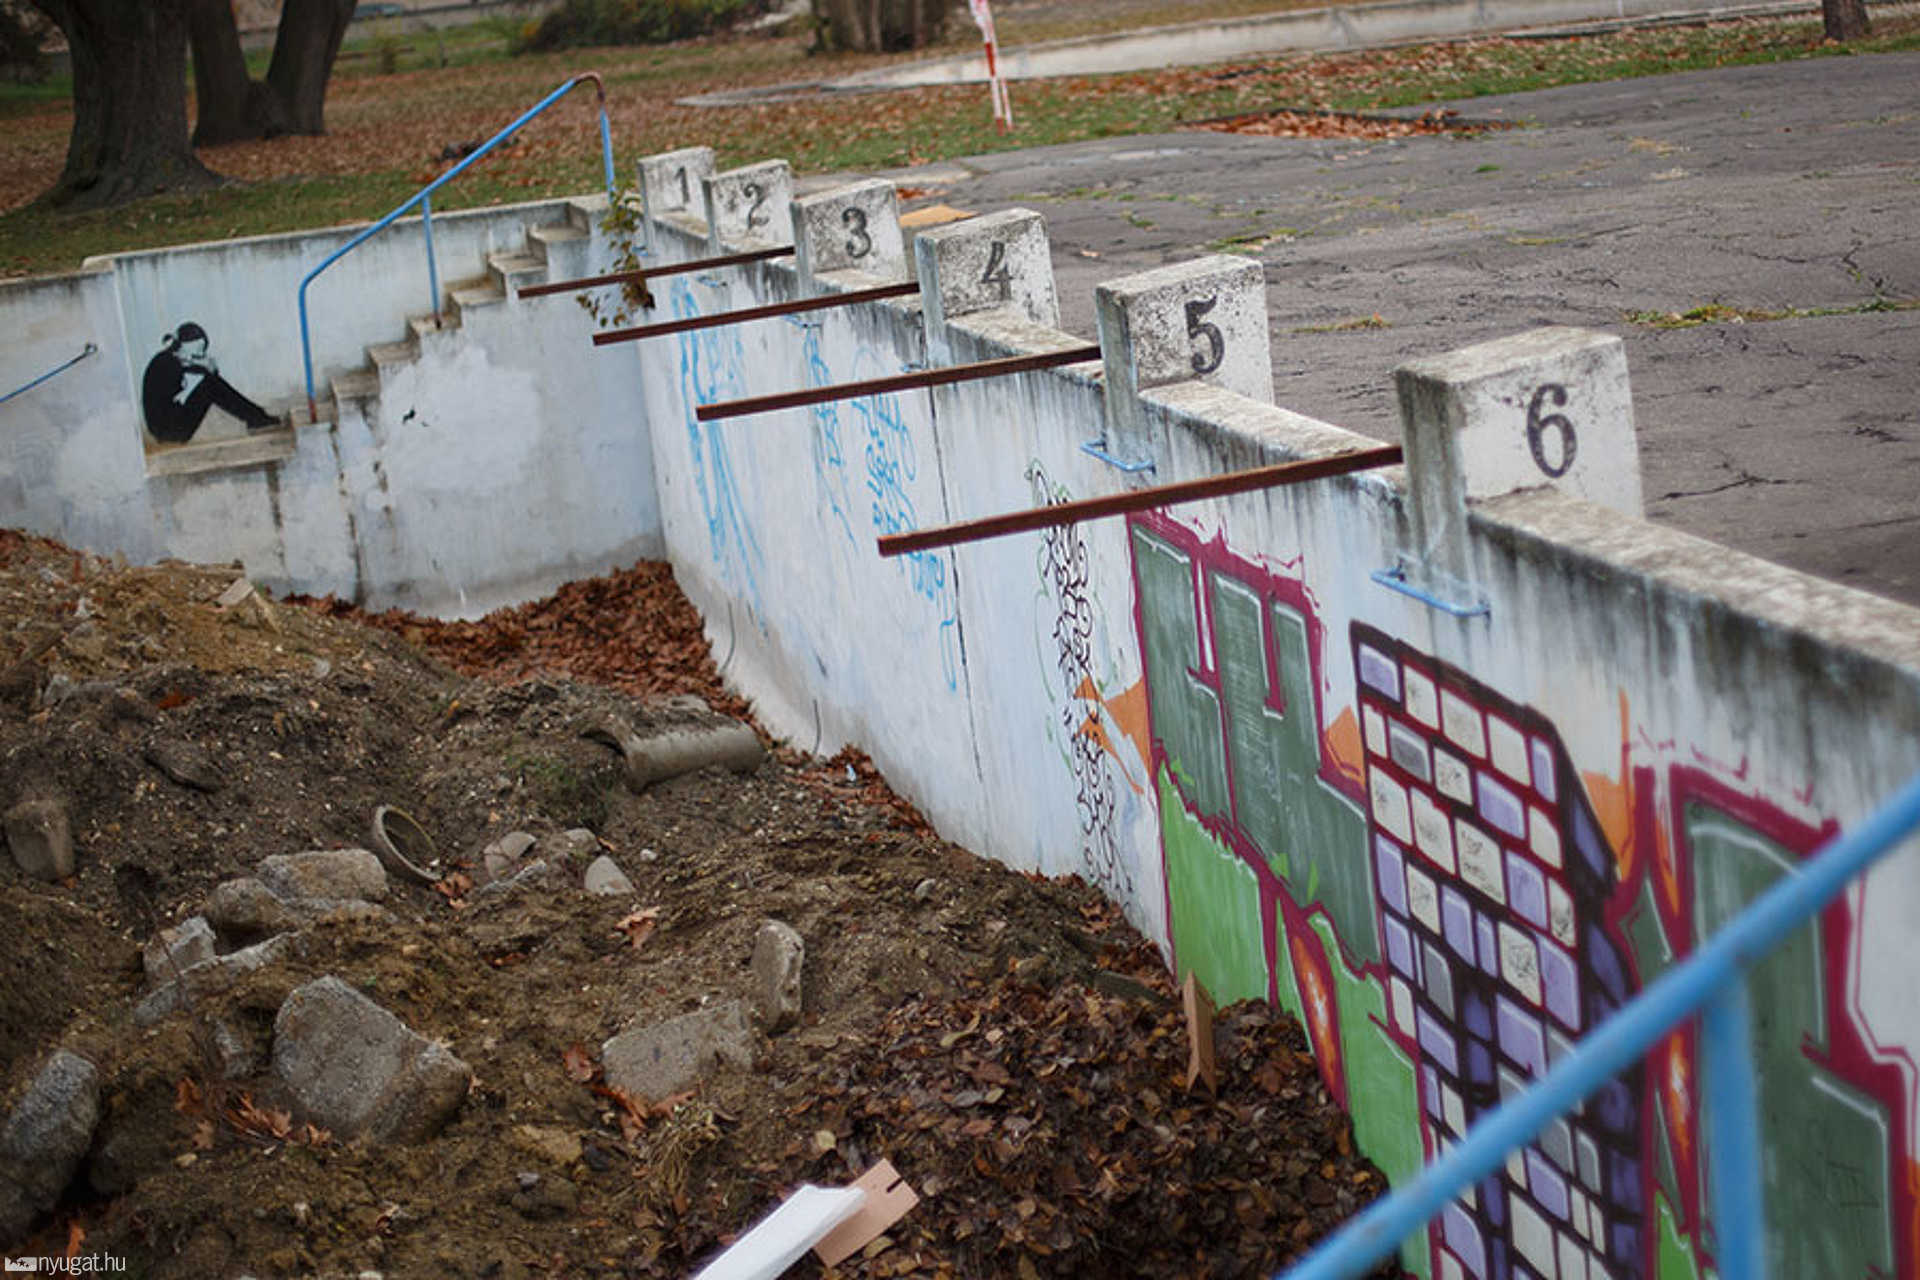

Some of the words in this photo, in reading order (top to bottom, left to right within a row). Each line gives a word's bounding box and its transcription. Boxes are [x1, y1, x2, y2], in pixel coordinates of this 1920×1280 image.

[673, 166, 691, 204] 1
[743, 183, 770, 230] 2
[841, 206, 871, 258] 3
[981, 241, 1015, 300] 4
[1184, 296, 1225, 374] 5
[1527, 383, 1577, 479] 6
